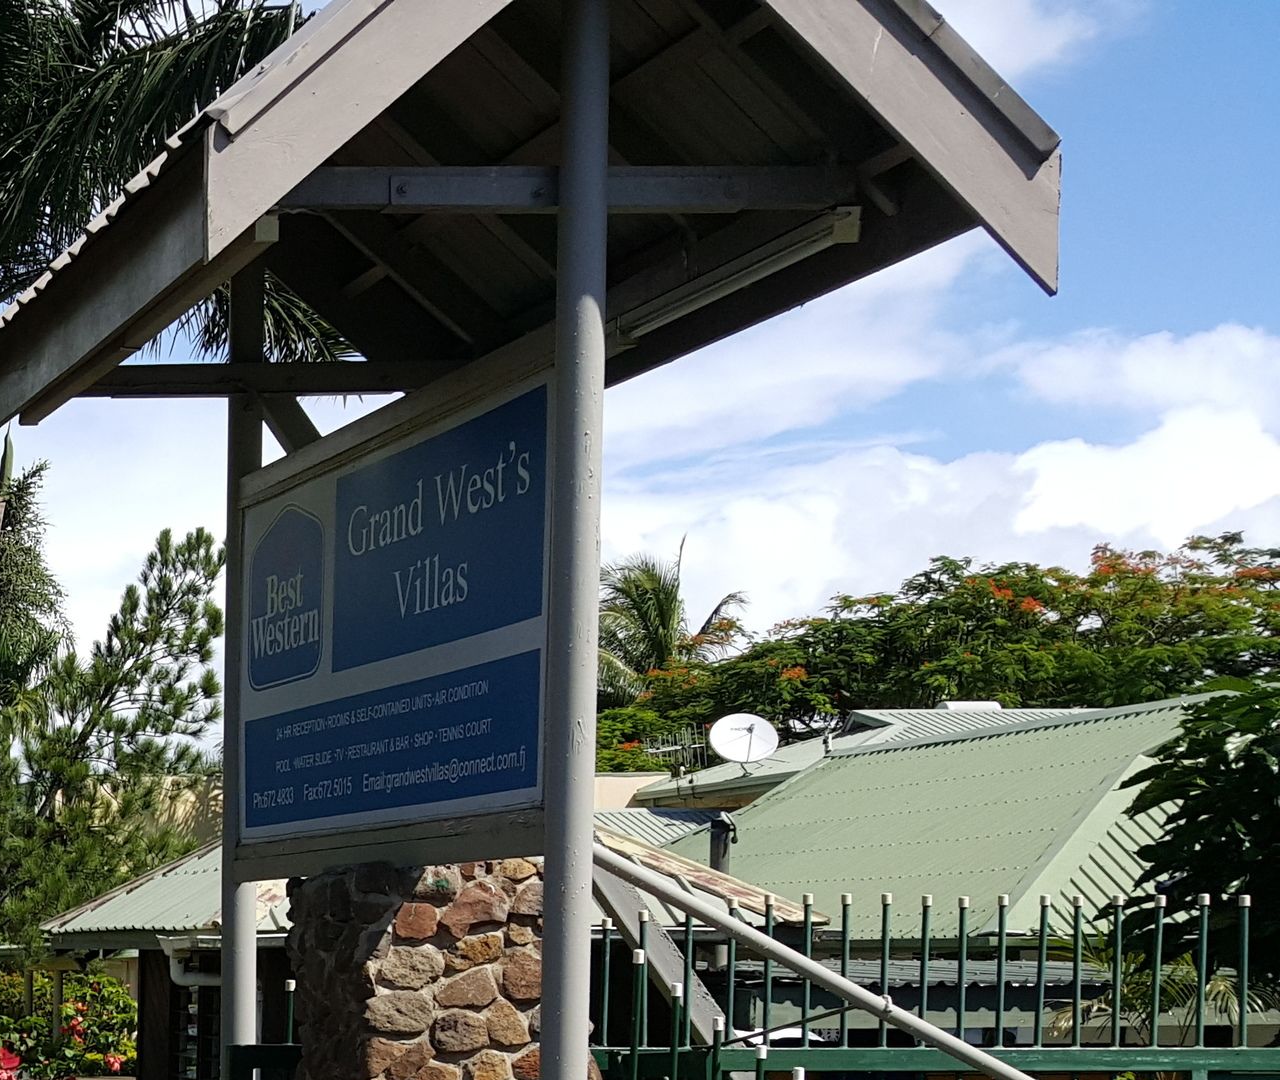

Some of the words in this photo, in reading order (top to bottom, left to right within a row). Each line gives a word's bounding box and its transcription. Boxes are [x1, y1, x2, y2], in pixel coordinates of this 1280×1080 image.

[347, 478, 423, 556] Grand
[434, 441, 531, 526] West's
[266, 566, 304, 618] Best
[393, 553, 468, 619] Villas
[251, 608, 320, 660] Western
[283, 725, 292, 739] HR
[350, 710, 355, 724] &
[356, 698, 411, 723] SELF-CONTAINED
[434, 690, 447, 705] AIR
[448, 680, 489, 703] CONDITION
[276, 759, 291, 774] POOL
[315, 750, 332, 766] SLIDE
[336, 748, 345, 761] TV
[347, 739, 389, 760] RESTAURANT
[389, 737, 395, 752] &
[395, 735, 410, 752] BAR
[414, 730, 434, 748] SHOP
[438, 724, 465, 743] TENNIS
[465, 718, 493, 738] COURT
